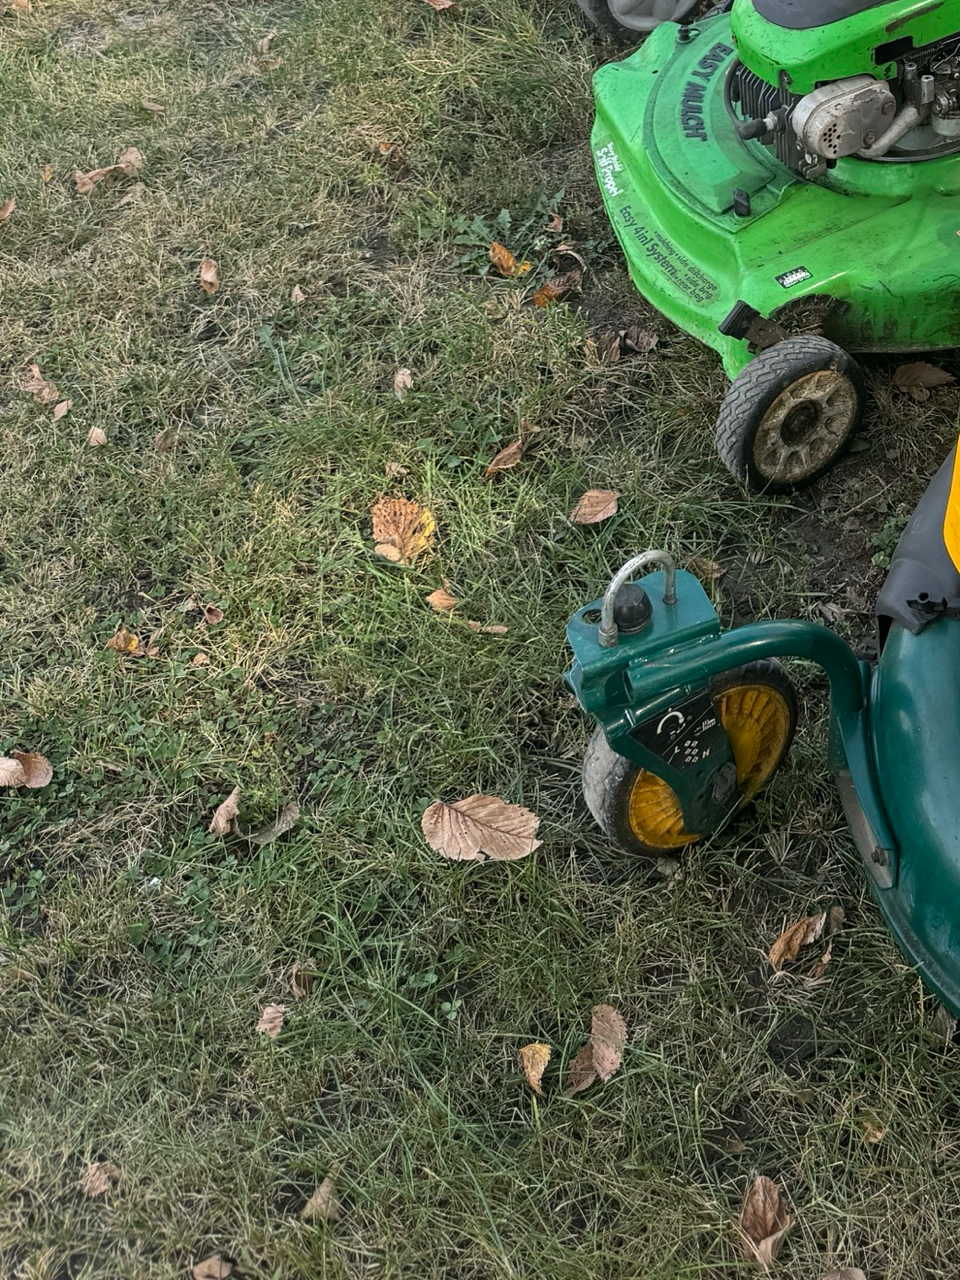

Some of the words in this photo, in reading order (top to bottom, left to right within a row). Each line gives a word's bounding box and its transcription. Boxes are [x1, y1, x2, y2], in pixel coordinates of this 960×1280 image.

[691, 41, 735, 83] EASY
[681, 81, 707, 140] MULCH
[601, 164, 625, 197] Propel
[619, 205, 638, 228] Easy
[633, 225, 649, 247] 4in1
[645, 242, 679, 277] System
[687, 266, 718, 291] discharge
